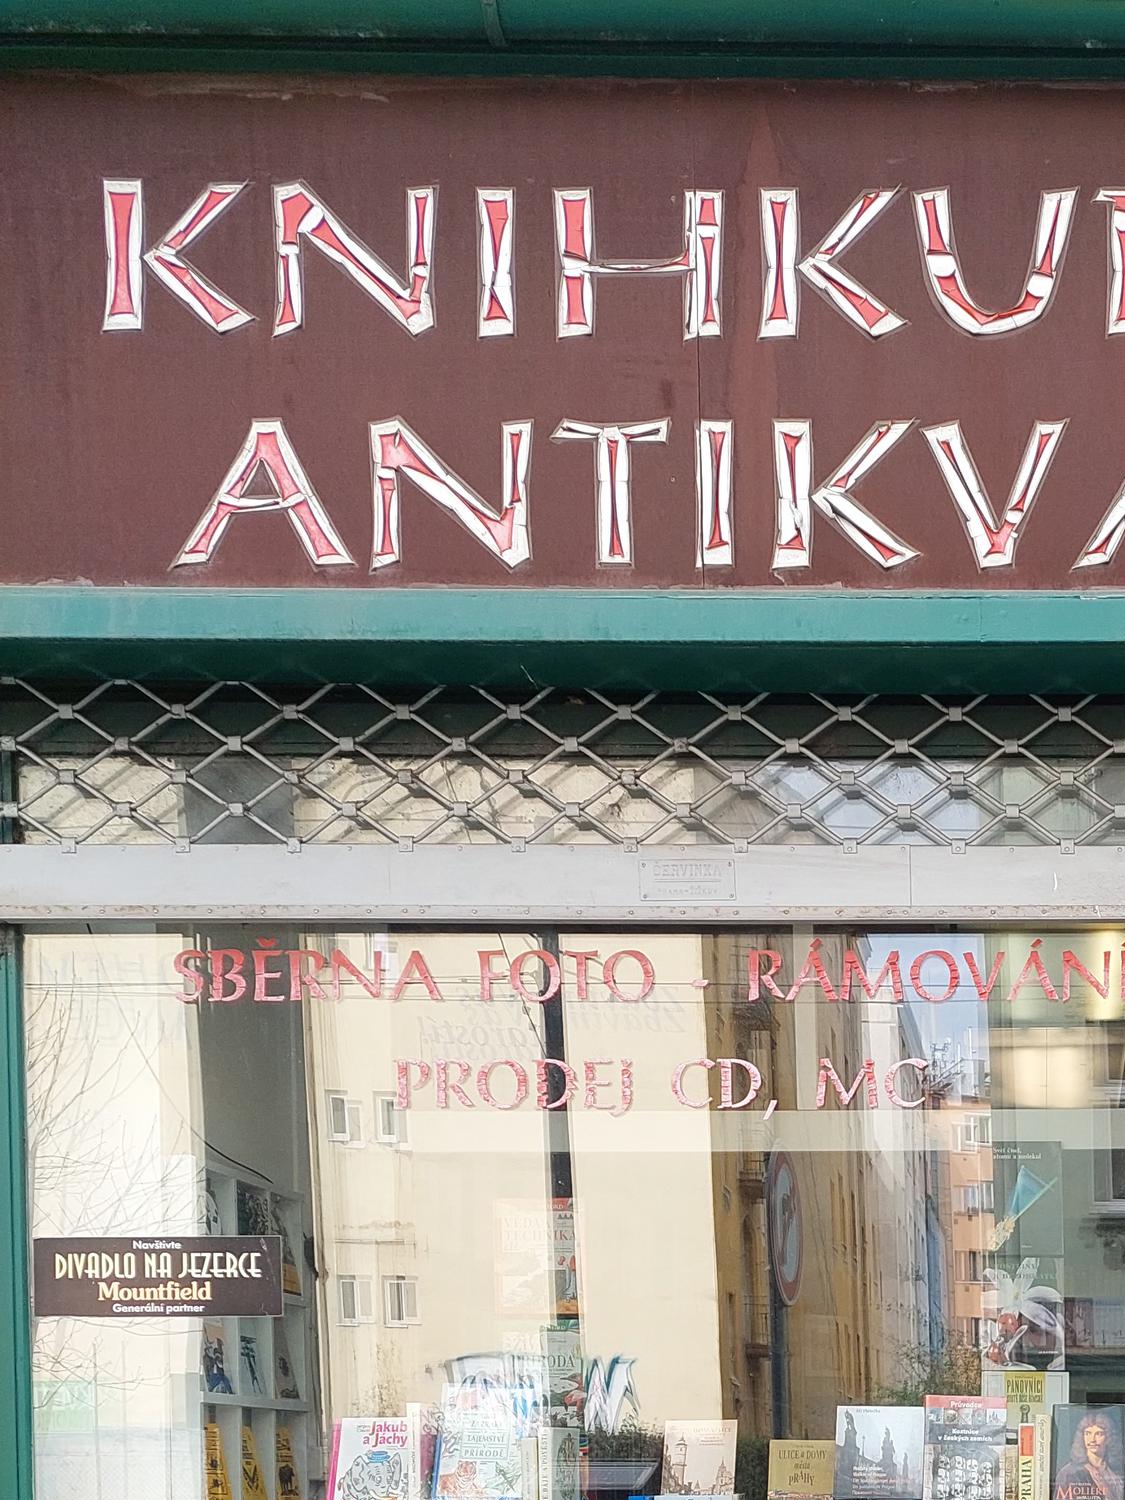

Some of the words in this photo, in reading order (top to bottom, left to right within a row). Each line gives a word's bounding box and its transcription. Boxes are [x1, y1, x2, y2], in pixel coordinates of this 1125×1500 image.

[172, 937, 443, 1005] SBĚRNA
[476, 949, 656, 1003] FOTO
[393, 1058, 634, 1117] PRODEJ
[671, 1057, 779, 1121] CD,
[815, 1056, 929, 1110] MC
[132, 1239, 182, 1250] Navštivte
[54, 1252, 136, 1280] DIVADLO
[144, 1253, 172, 1279] NA
[178, 1252, 263, 1279] JEZERCE
[98, 1281, 213, 1301] Mountfield
[112, 1302, 164, 1313] Generální
[165, 1303, 205, 1315] partner
[1006, 1378, 1043, 1394] PANOVNÍCI
[369, 1420, 408, 1436] Jakub
[363, 1436, 370, 1445] a
[371, 1432, 408, 1448] Jáchy
